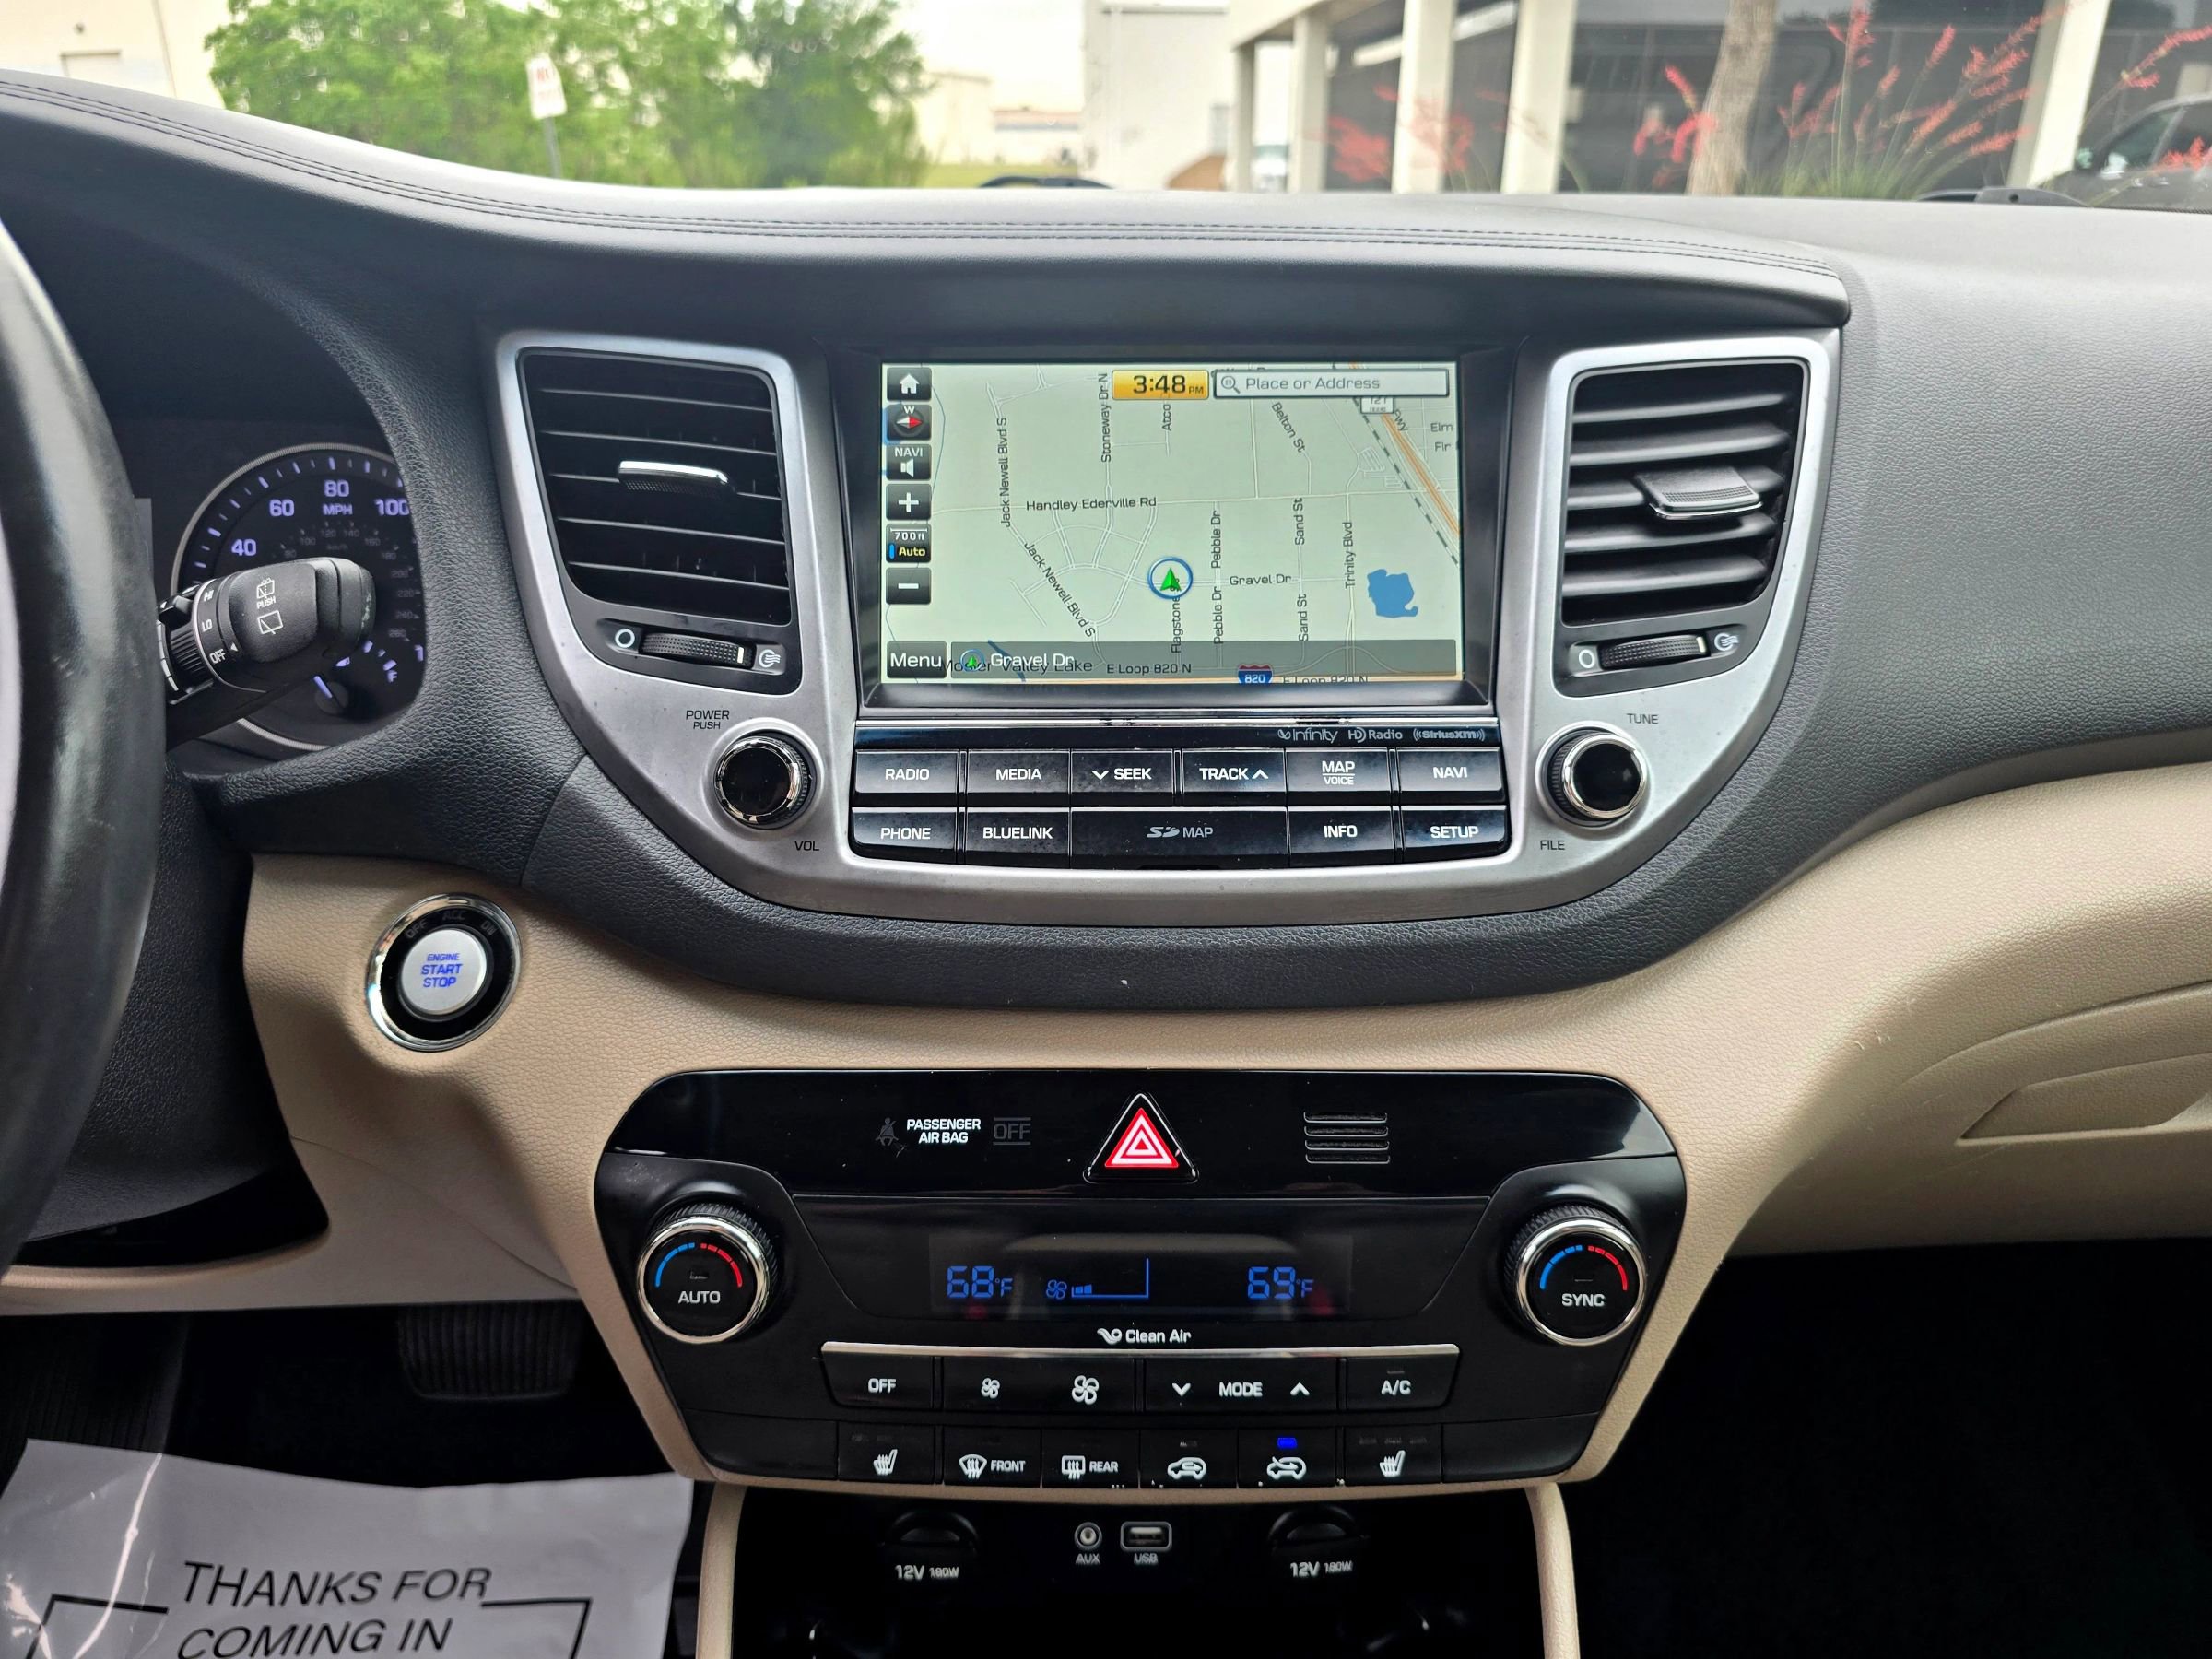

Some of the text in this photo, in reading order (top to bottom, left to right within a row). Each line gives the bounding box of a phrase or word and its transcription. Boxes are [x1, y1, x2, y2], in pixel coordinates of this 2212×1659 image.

[1133, 375, 1204, 394] 3:48 PM
[1246, 377, 1381, 390] Place or Address
[903, 406, 915, 414] W
[1099, 373, 1112, 463] Stoneway Dr N
[1162, 404, 1172, 431] Atco
[1272, 402, 1306, 453] Belton St
[1430, 423, 1453, 432] Elm
[894, 447, 924, 458] NAVI
[997, 418, 1011, 528] Jack Newell Blvd S
[324, 479, 349, 497] 80
[269, 499, 295, 517] 60
[323, 504, 353, 516] MPH
[374, 499, 410, 516] 100
[1026, 497, 1157, 512] Handley Ederville Rd
[1293, 498, 1306, 546] Sand St
[1211, 511, 1222, 569] Pebble Dr
[231, 538, 257, 557] 40
[899, 547, 926, 558] Auto
[1342, 522, 1357, 590] Trinity Blvd
[1230, 573, 1292, 586] Gravel Dr
[203, 589, 215, 602] HI
[1024, 542, 1097, 638] Jack Newell Blvd S
[256, 595, 276, 609] PUSH
[1212, 586, 1224, 645] Pebble Dr
[1297, 594, 1309, 642] Sand St
[201, 618, 213, 633] LO
[209, 648, 227, 665] OFF
[890, 653, 943, 668] Menu
[991, 653, 1075, 667] Gravel Dr
[1107, 663, 1192, 676] E Loop 820 N
[1244, 674, 1266, 683] 820
[686, 710, 730, 721] POWER
[1626, 712, 1659, 725] TUNE
[692, 721, 722, 731] PUSH
[1369, 728, 1404, 741] Radio
[1321, 760, 1356, 773] MAP
[1432, 766, 1468, 780] NAVI
[884, 768, 931, 782] RADIO
[995, 768, 1042, 782] MEDIA
[1113, 767, 1153, 781] SEEK
[1199, 767, 1250, 782] TRACK
[1324, 775, 1355, 786] VOICE
[880, 827, 932, 841] PHONE
[982, 827, 1053, 841] BLUELINK
[1182, 827, 1215, 839] MAP
[1324, 825, 1359, 839] INFO
[1430, 825, 1480, 839] SETUP
[794, 840, 820, 852] VOL
[1539, 840, 1566, 851] FILE
[427, 953, 461, 961] ENGINE
[420, 963, 464, 975] START
[423, 977, 457, 988] STOP
[906, 1117, 982, 1131] PASSENGER
[918, 1131, 970, 1145] AIR BAG
[992, 1123, 1032, 1141] OFF
[677, 1290, 722, 1305] AUTO
[1560, 1292, 1606, 1308] SYNC
[1124, 1328, 1193, 1345] Clean Air
[867, 1378, 897, 1394] OFF
[1218, 1382, 1264, 1398] MODE
[1381, 1379, 1412, 1396] A/C
[990, 1459, 1026, 1473] FRONT
[1088, 1460, 1119, 1473] REAR
[1075, 1552, 1100, 1565] AUX
[1133, 1552, 1159, 1565] USB
[896, 1564, 924, 1581] 12V
[1290, 1561, 1320, 1578] 12V
[183, 1561, 493, 1607] THANKS FOR
[177, 1618, 454, 1659] COMING IN
